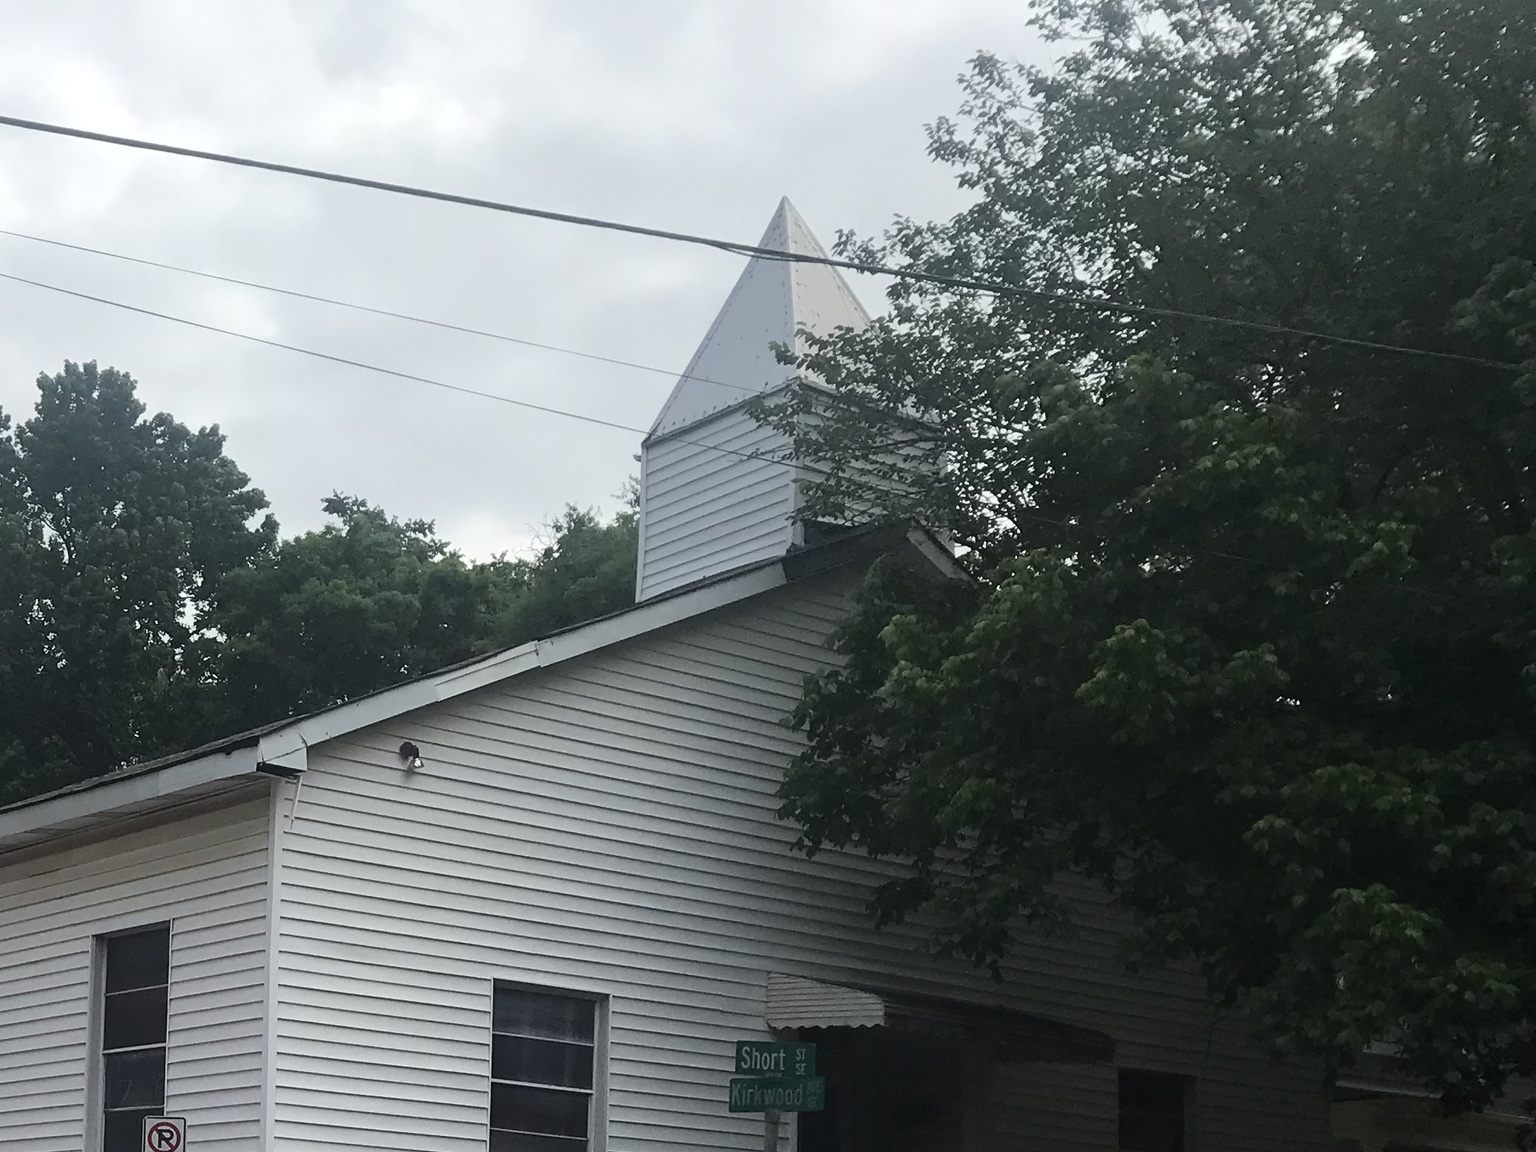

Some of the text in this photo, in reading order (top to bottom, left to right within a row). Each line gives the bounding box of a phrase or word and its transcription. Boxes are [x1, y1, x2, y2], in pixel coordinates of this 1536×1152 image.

[741, 1046, 806, 1070] Short ST
[795, 1063, 806, 1075] SE
[731, 1083, 803, 1106] Kirkwood
